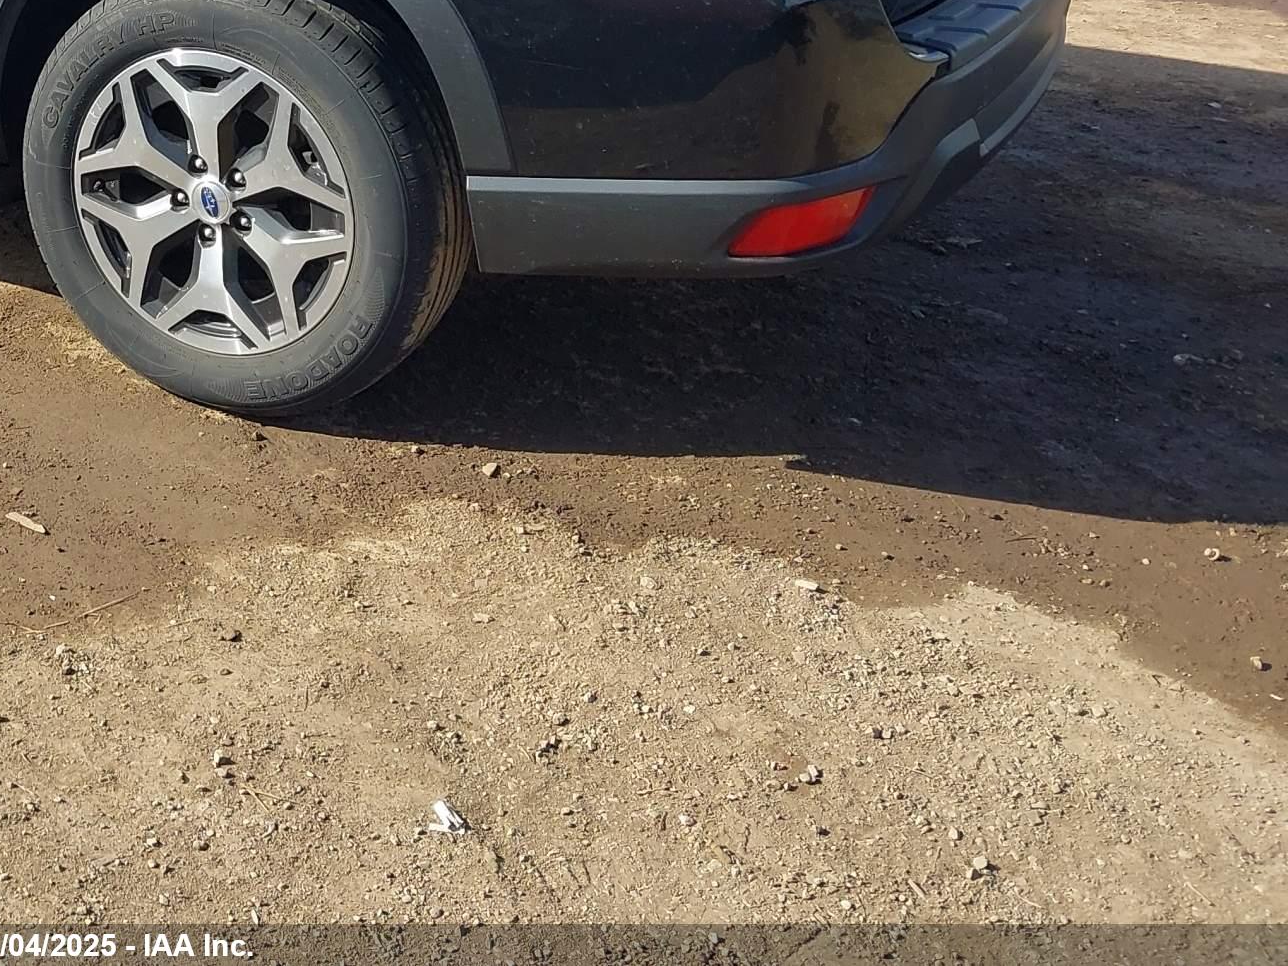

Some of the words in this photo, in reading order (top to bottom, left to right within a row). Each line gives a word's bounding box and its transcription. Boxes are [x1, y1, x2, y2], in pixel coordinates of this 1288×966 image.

[43, 19, 130, 129] CAVALRY
[137, 12, 175, 37] HP
[244, 316, 375, 400] ROADONE
